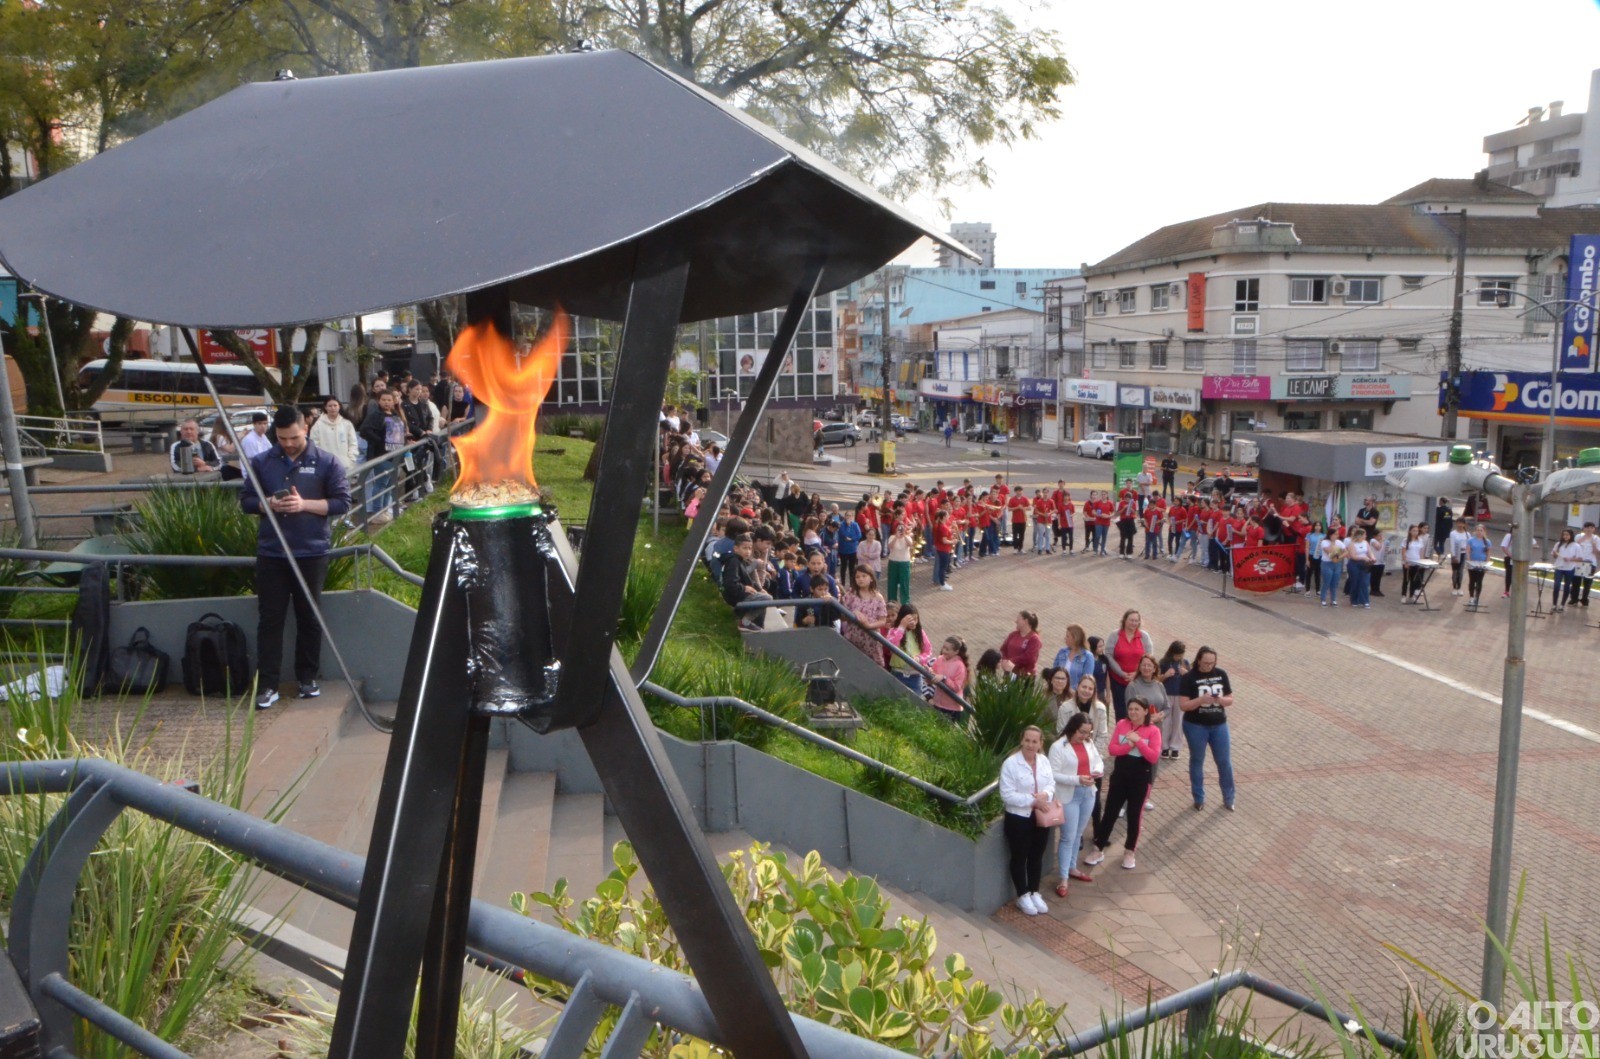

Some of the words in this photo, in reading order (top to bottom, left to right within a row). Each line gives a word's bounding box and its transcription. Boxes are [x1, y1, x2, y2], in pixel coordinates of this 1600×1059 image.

[1573, 245, 1595, 333] Colombo
[1289, 380, 1300, 395] LE
[1303, 380, 1329, 395] CAMP
[134, 393, 199, 404] ESCOLAR
[1394, 452, 1419, 460] BRIGADA
[1394, 460, 1418, 468] MILITAR
